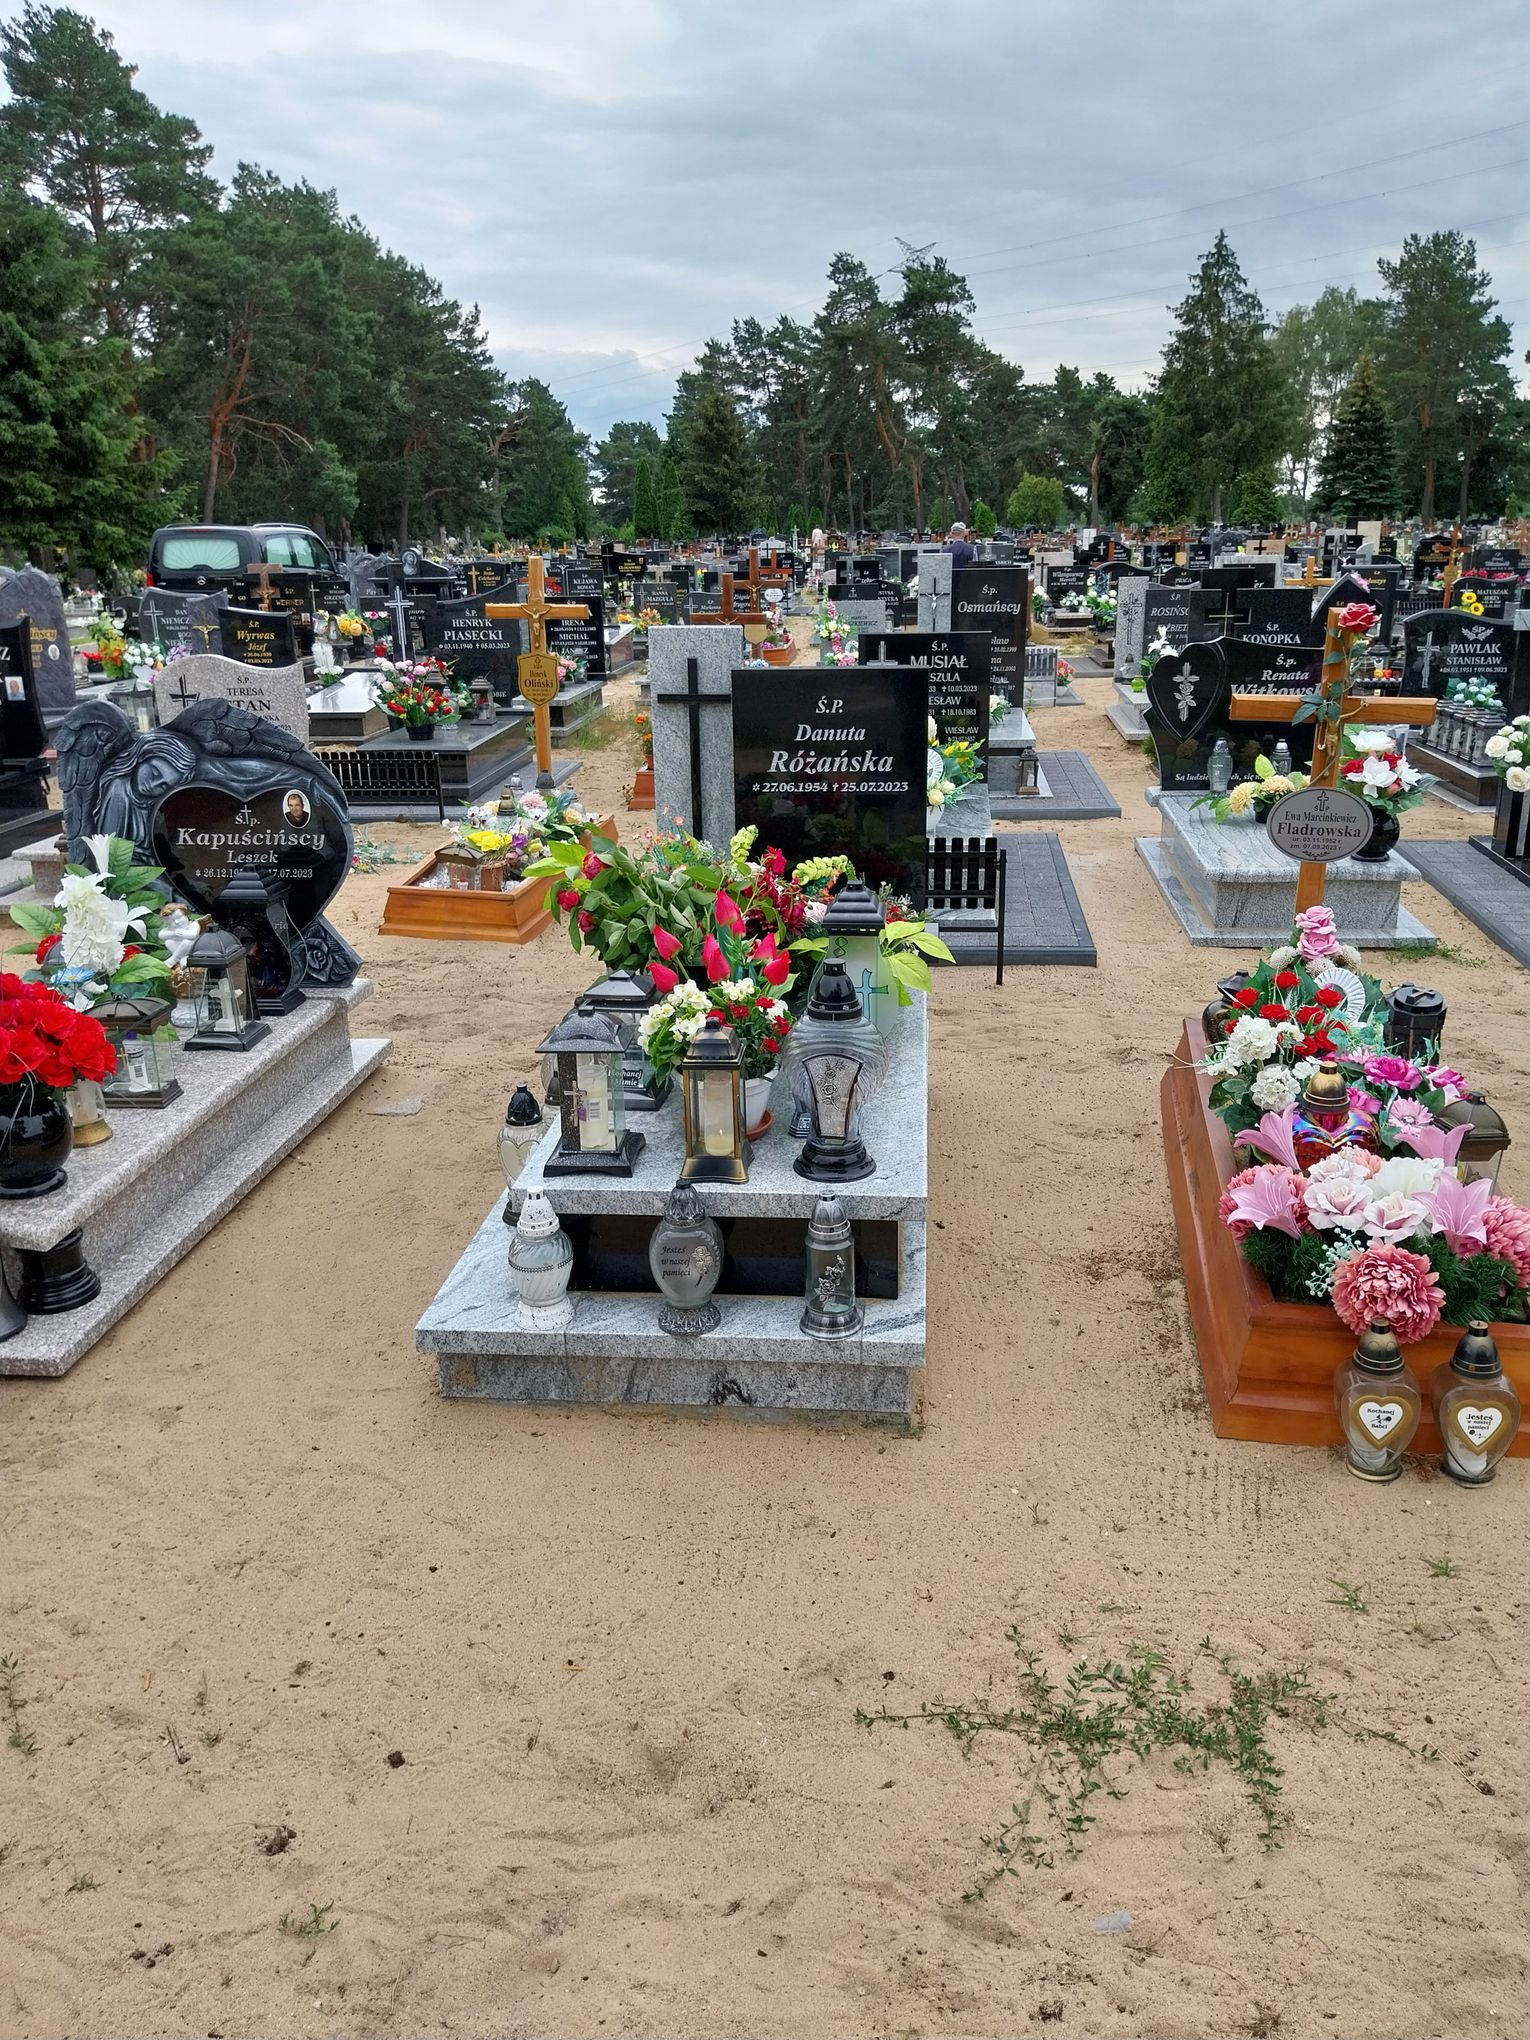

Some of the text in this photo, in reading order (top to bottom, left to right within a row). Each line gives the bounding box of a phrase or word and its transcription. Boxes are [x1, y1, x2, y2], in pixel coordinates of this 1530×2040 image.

[957, 600, 1021, 615] Osmańscy
[452, 618, 493, 628] HENRYK
[236, 630, 276, 642] Wyrwas
[443, 629, 504, 641] PIASECKI
[1242, 633, 1301, 644] KONOPKA
[247, 643, 268, 652] Józef
[1450, 643, 1502, 654] PAWLAK
[909, 654, 969, 669] MUSIAŁ
[1446, 656, 1503, 665] STANISŁAW
[929, 672, 961, 682] SZULA
[1260, 669, 1310, 681] Renata
[524, 678, 554, 689] Oliński
[1230, 683, 1322, 695] Witkowsk
[226, 687, 265, 697] TERESA
[229, 699, 272, 712] TAN
[815, 695, 844, 714] Ś.P.
[928, 695, 962, 706] ESŁAW
[793, 723, 867, 742] Danuta
[944, 726, 980, 735] WIESŁAW
[767, 749, 894, 775] Różańska
[762, 781, 909, 793] 27.06.1954 25.07.2023
[1284, 811, 1358, 824] Ewa Marcinkiewicz
[1276, 822, 1361, 838] Fladrowska
[175, 827, 326, 850] Kapuścińscy
[226, 850, 279, 864] Leszek
[203, 867, 244, 879] 26.12.19
[660, 1245, 687, 1256] Jesteś
[669, 1258, 691, 1268] naszej
[661, 1268, 692, 1280] pamięci
[1367, 1408, 1395, 1416] Kochanej
[1465, 1413, 1494, 1421] Jesteś
